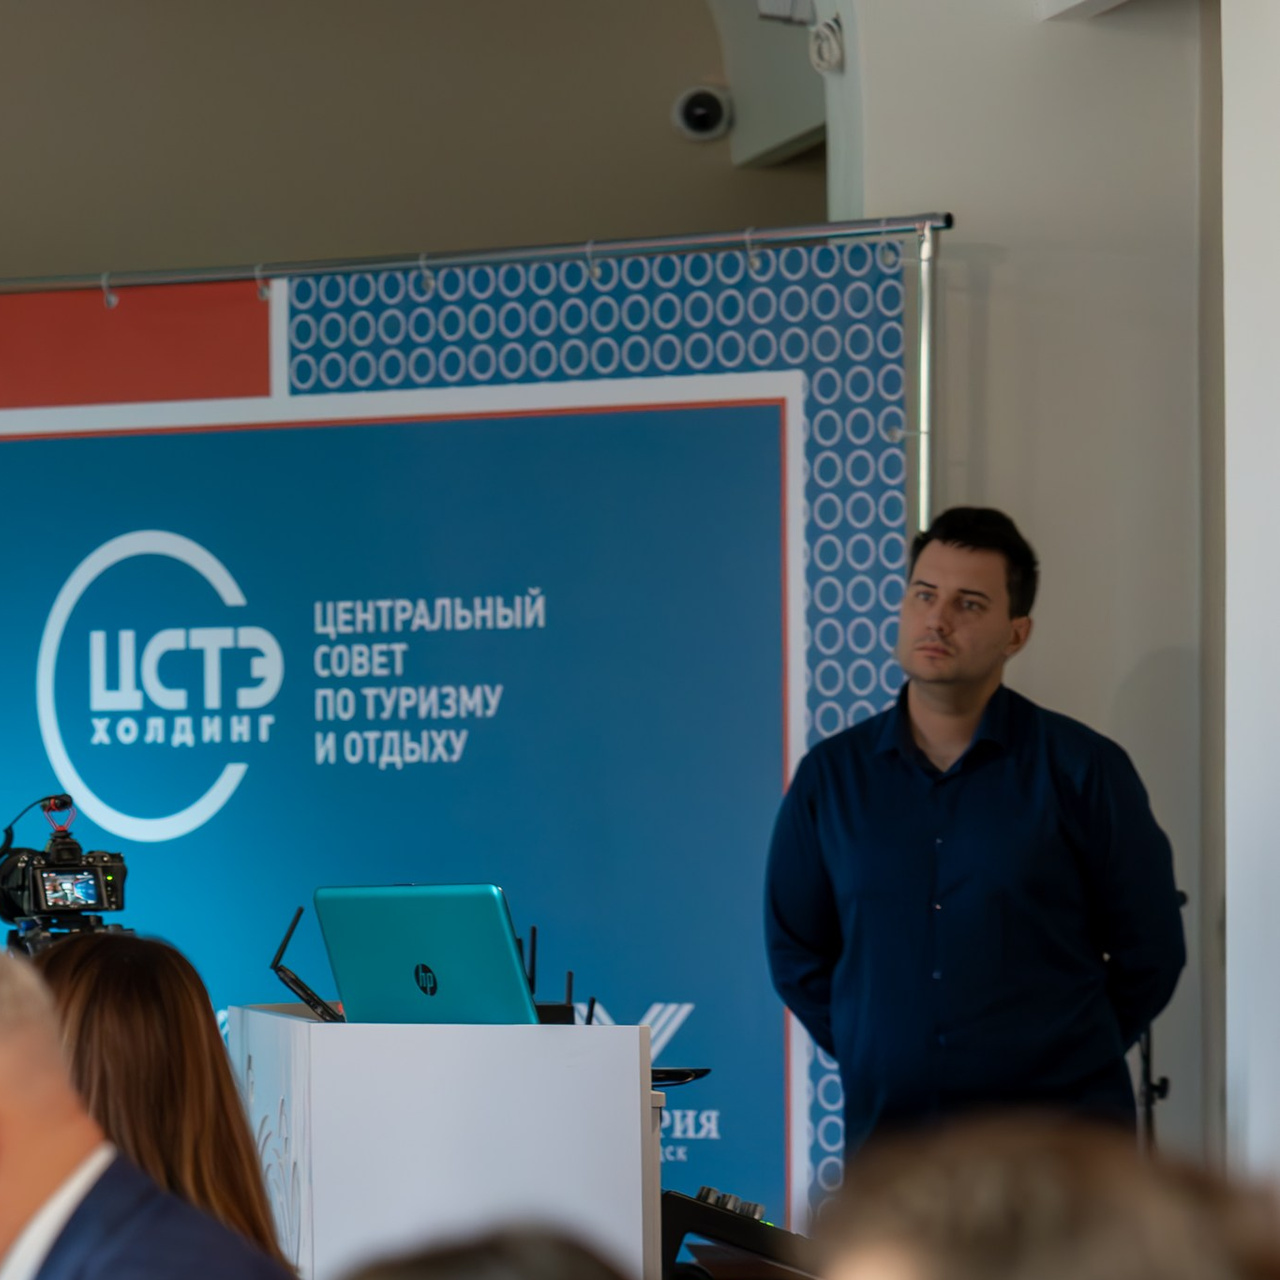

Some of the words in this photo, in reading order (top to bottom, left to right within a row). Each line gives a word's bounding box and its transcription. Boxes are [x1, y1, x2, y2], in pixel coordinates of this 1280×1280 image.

[314, 587, 546, 640] ЦЕНТРАЛЬНЫЙ
[89, 625, 284, 712] ЦСТЭ
[313, 642, 409, 678] СОВЕТ
[314, 687, 356, 722] ПО
[360, 684, 504, 721] ТУРИЗМУ
[89, 714, 276, 748] ХОЛДИНГ
[315, 731, 337, 765] И
[342, 729, 469, 771] ОТДЫХУ
